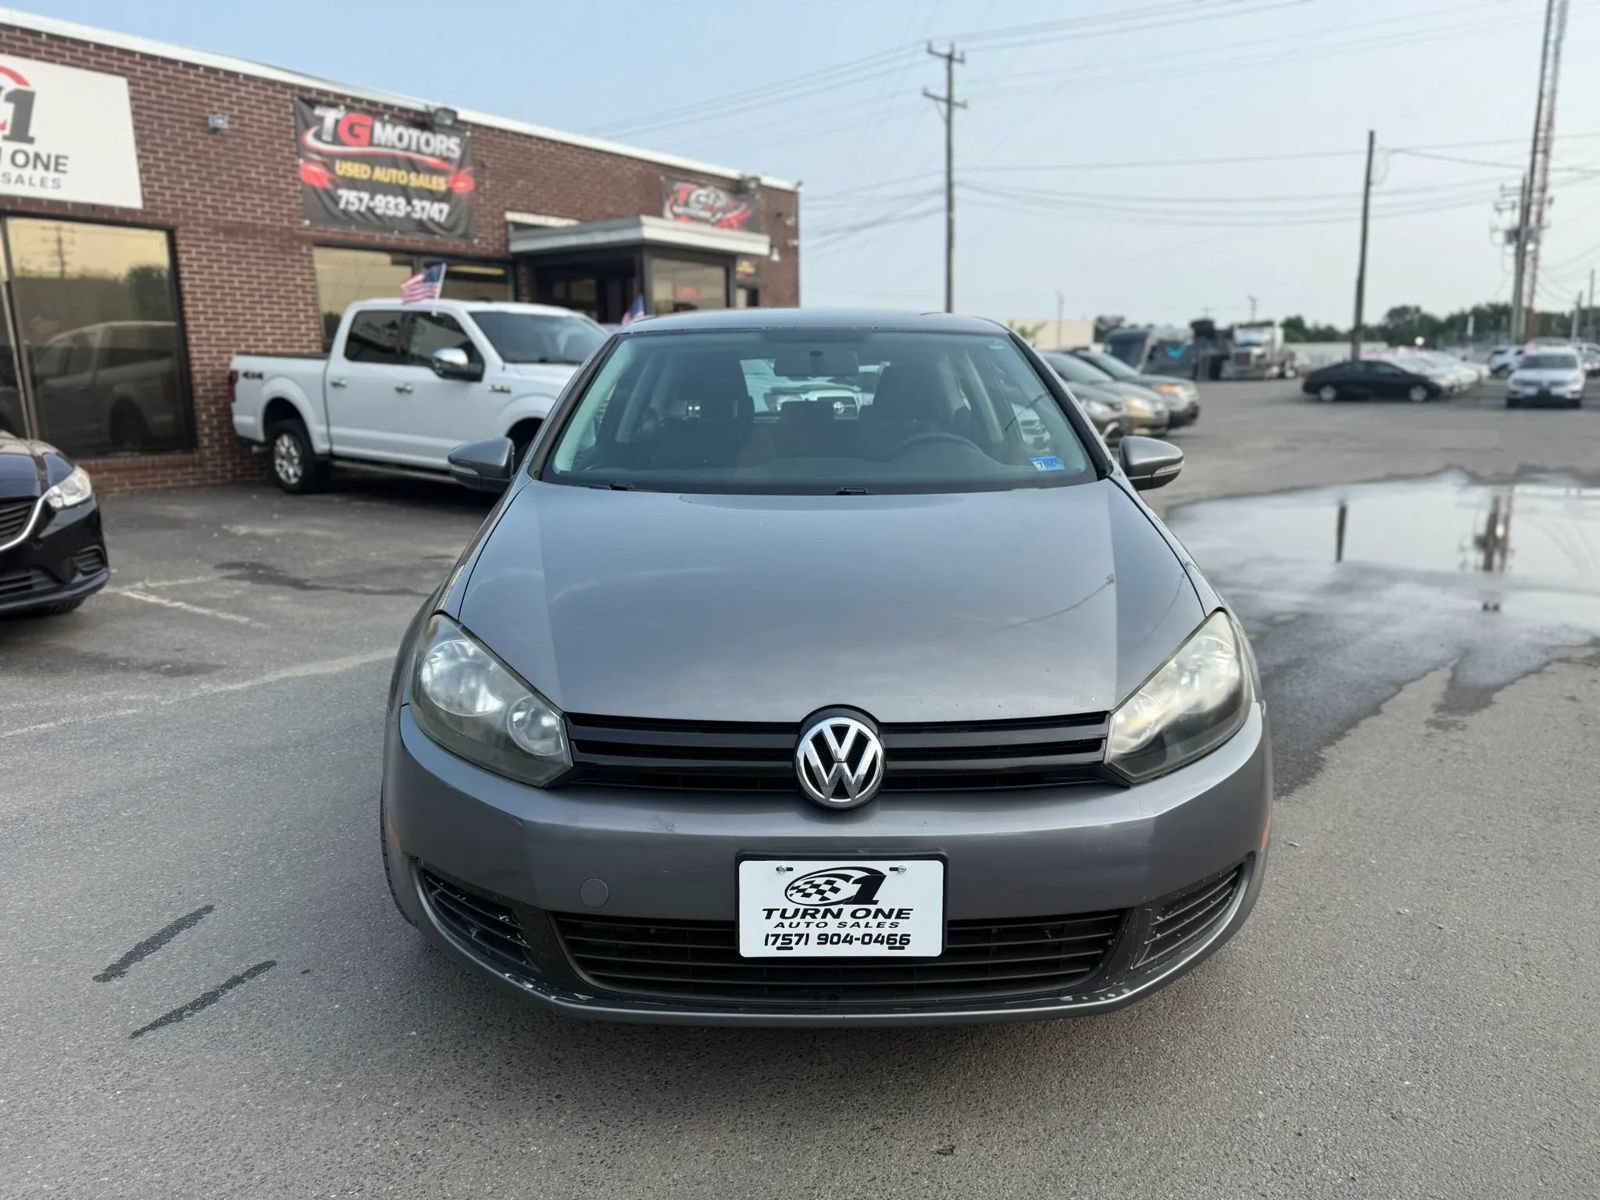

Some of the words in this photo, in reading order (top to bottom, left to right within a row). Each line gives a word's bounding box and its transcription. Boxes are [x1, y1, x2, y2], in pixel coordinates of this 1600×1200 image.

[314, 105, 374, 147] TG
[373, 121, 461, 159] MOTORS
[10, 149, 69, 174] ONE
[1, 172, 62, 190] SALES
[335, 159, 371, 180] USED
[372, 166, 408, 186] AUTO
[409, 171, 448, 193] SALES
[336, 188, 450, 223] 757-933-3747
[762, 908, 844, 920] TURN
[850, 908, 914, 920] ONE
[773, 921, 829, 929] AUTO
[837, 921, 900, 929] SALES
[764, 933, 810, 947] (757)
[816, 933, 911, 946] 904-0466
